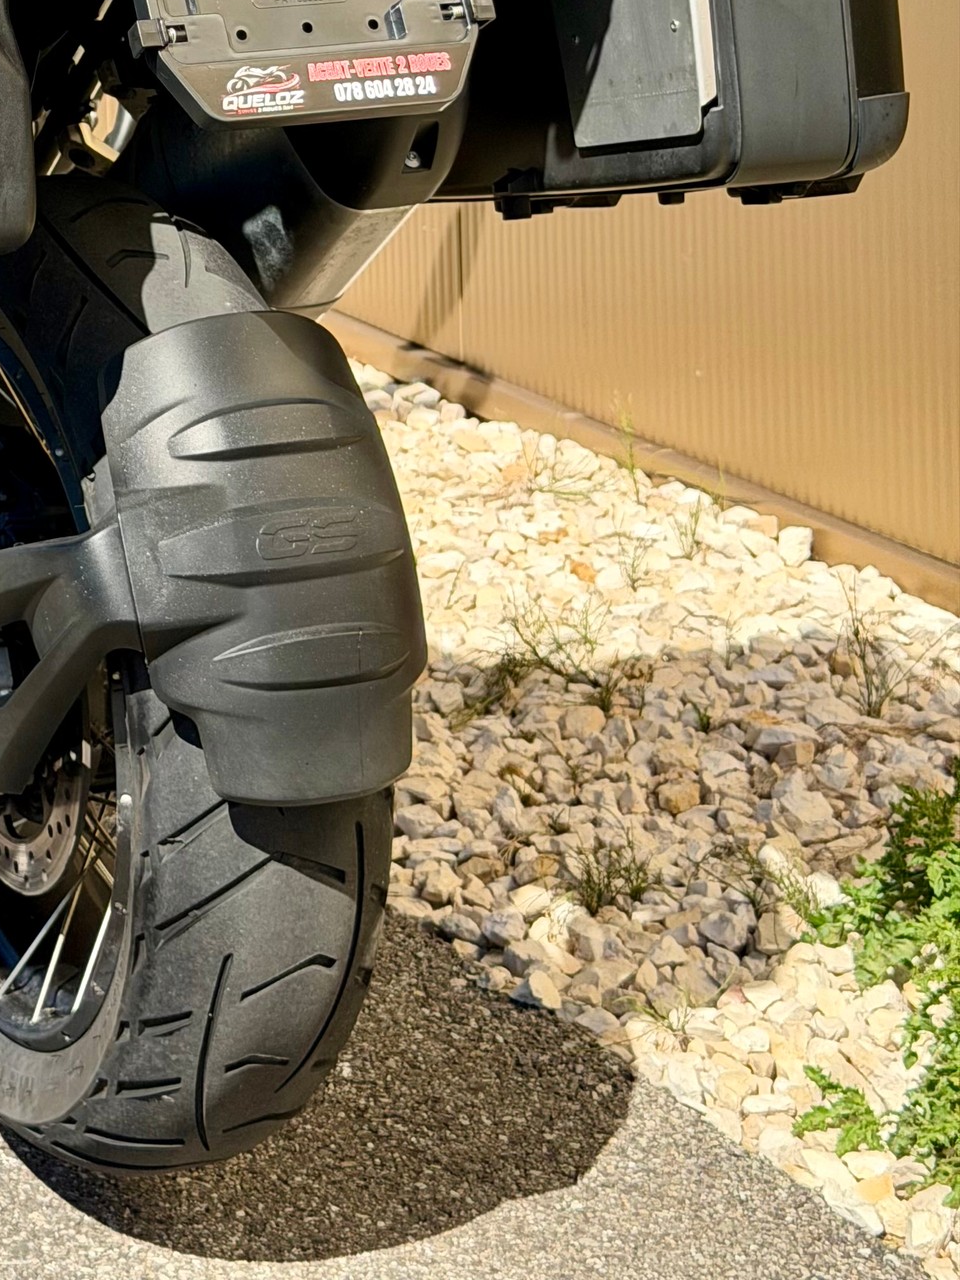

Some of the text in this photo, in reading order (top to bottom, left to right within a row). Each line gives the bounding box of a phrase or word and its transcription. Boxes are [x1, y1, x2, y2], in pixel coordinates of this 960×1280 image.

[395, 55, 408, 74] 2
[407, 52, 451, 73] ROUES
[222, 90, 305, 111] QUELOZ
[333, 75, 436, 102] 078 604 28 24
[256, 507, 360, 560] GS
